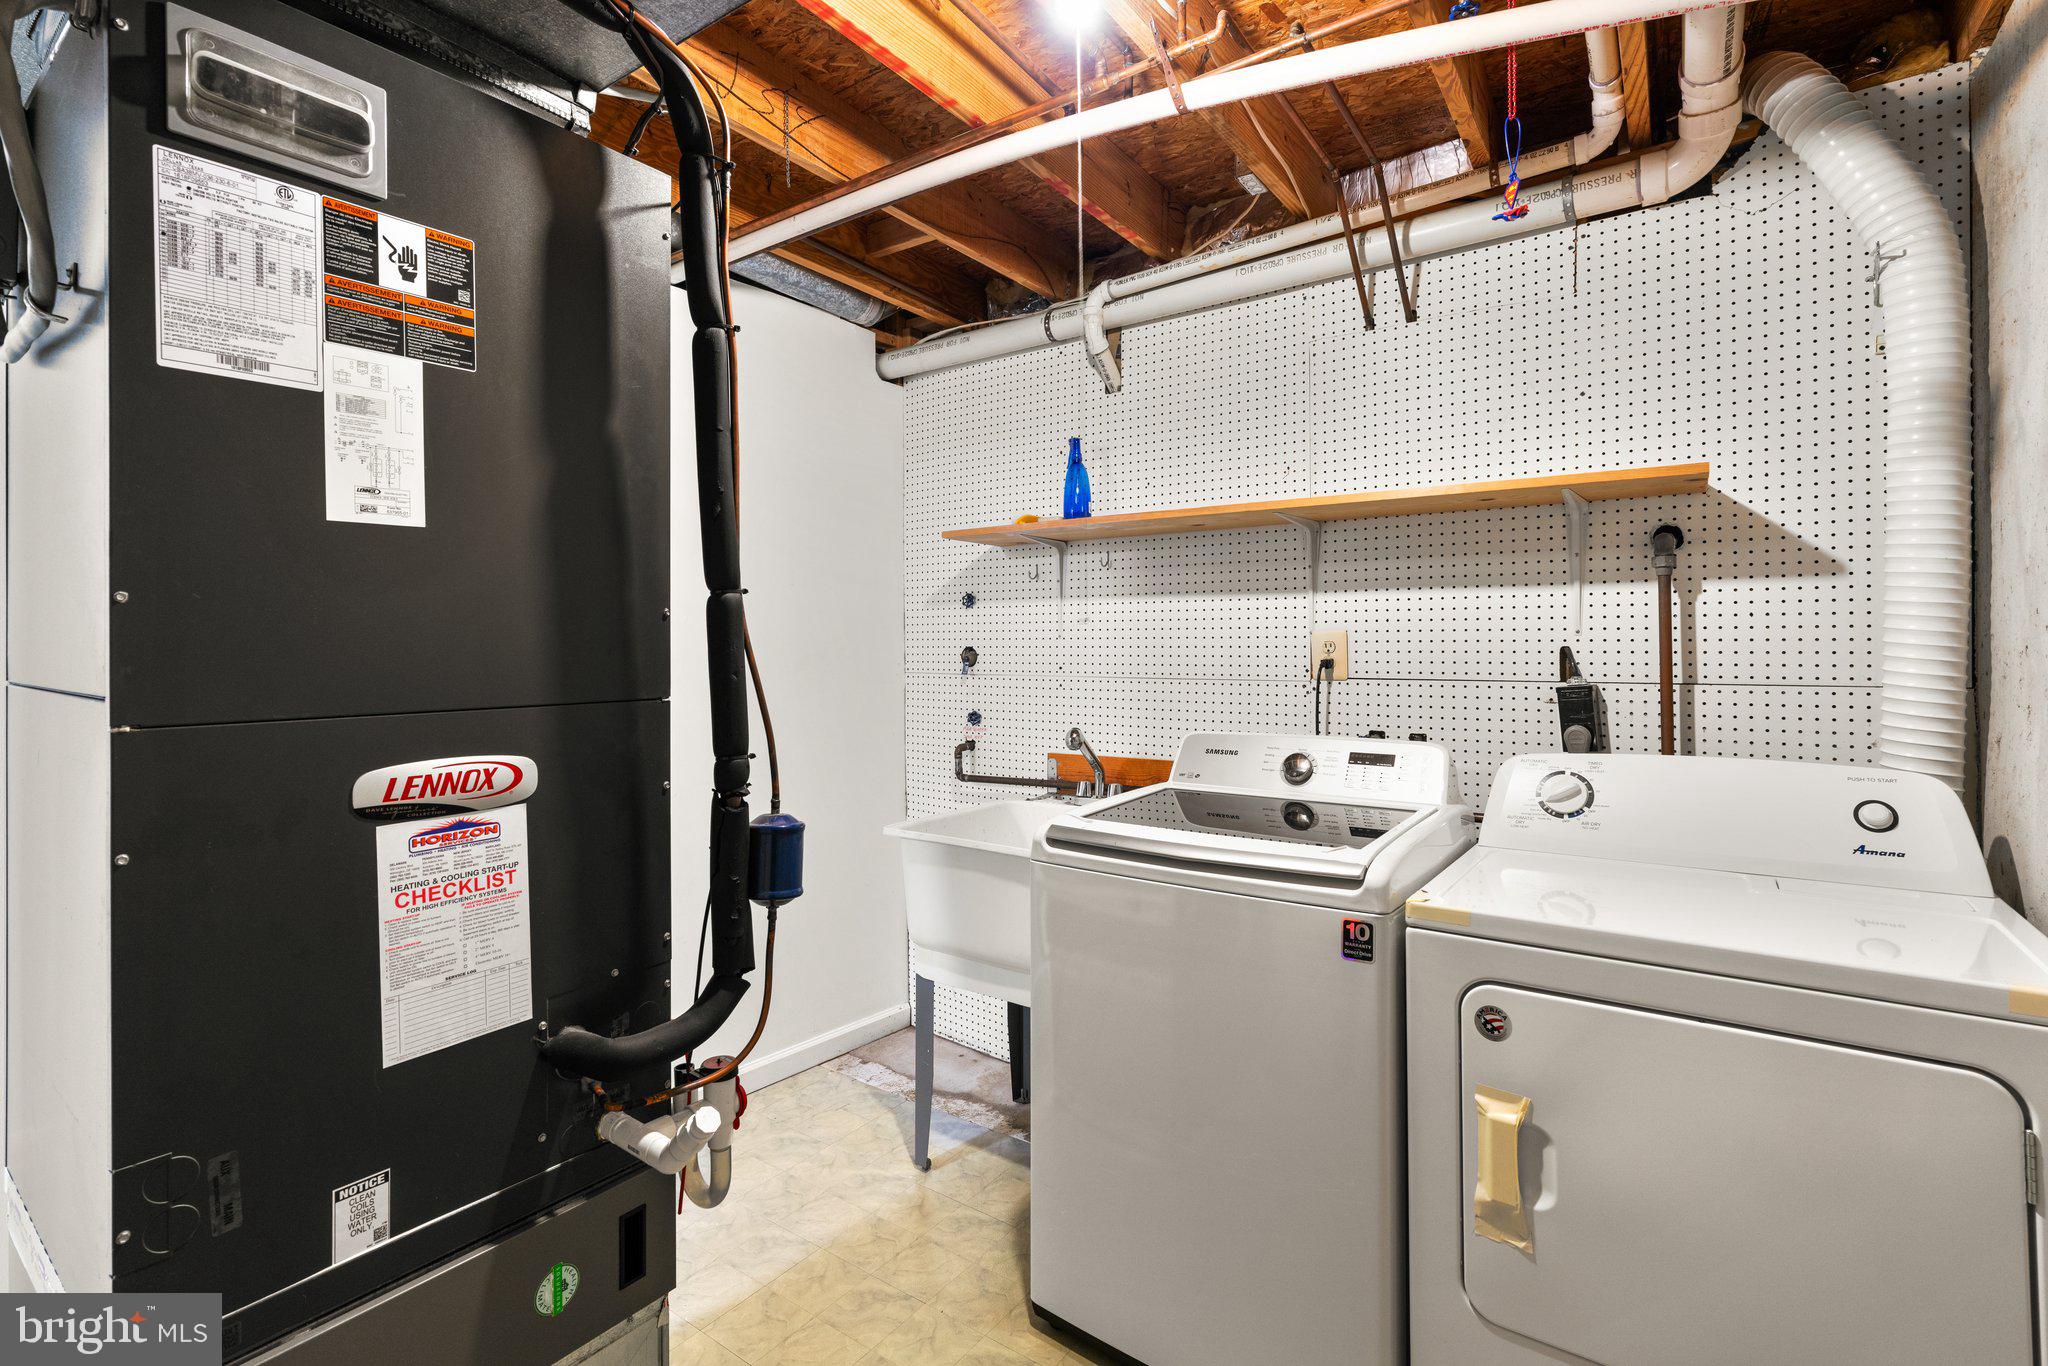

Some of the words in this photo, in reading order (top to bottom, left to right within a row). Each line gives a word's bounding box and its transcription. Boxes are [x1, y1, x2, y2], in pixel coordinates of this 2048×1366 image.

[163, 150, 193, 164] LENNOX
[1567, 172, 1622, 194] PRESSUR
[334, 203, 376, 218] AVERTISSEMENT
[436, 233, 470, 248] WARNING
[1285, 247, 1328, 265] PRESSURE
[337, 280, 401, 299] AVERTISSEMENT
[337, 299, 401, 318] AVERTISSEMENT
[428, 301, 462, 314] WARNING
[428, 321, 462, 333] WARNING
[382, 767, 499, 802] LENNOX
[411, 824, 498, 848] HORIZON
[1853, 845, 1905, 857] Amana
[390, 879, 429, 893] HEATING
[440, 868, 478, 883] COOLING
[482, 860, 518, 874] START-UP
[394, 868, 516, 909] CHECKLIST
[406, 906, 420, 914] FOR
[422, 902, 438, 911] HIGH
[440, 893, 477, 907] EFFICIENCY
[478, 886, 507, 898] SYSTEMS
[1346, 922, 1370, 941] 10
[1477, 1007, 1507, 1020] AMERICA
[339, 1173, 385, 1201] NOTICE
[348, 1190, 376, 1206] CLEAN
[350, 1198, 375, 1214] COILS
[347, 1213, 377, 1230] WATER
[350, 1206, 375, 1221] USING
